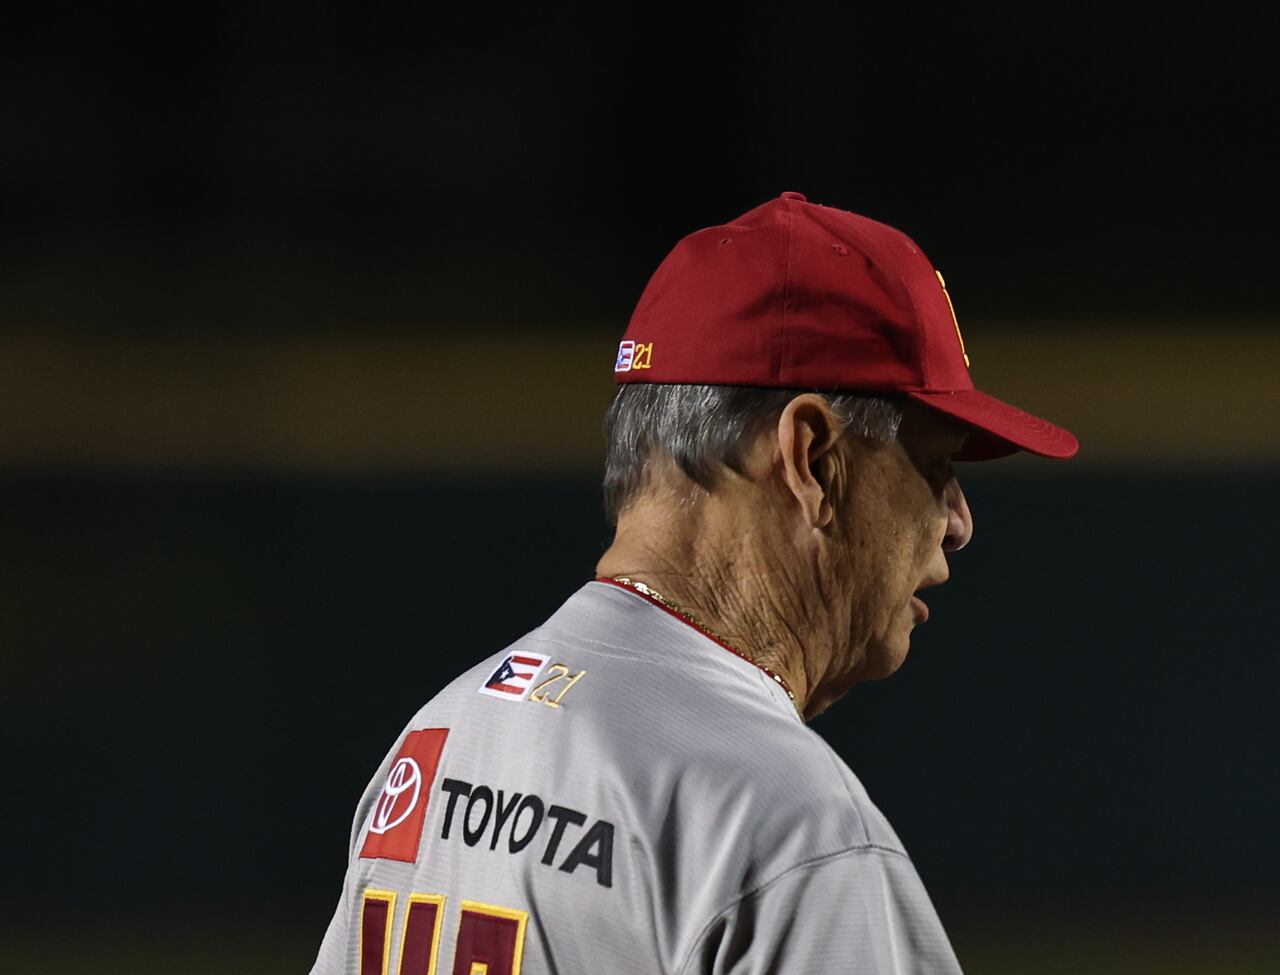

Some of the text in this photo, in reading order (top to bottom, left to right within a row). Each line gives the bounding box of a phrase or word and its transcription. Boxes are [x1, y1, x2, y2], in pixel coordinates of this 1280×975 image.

[632, 343, 653, 369] 21
[528, 663, 587, 709] 21
[441, 778, 614, 888] TOYOTA
